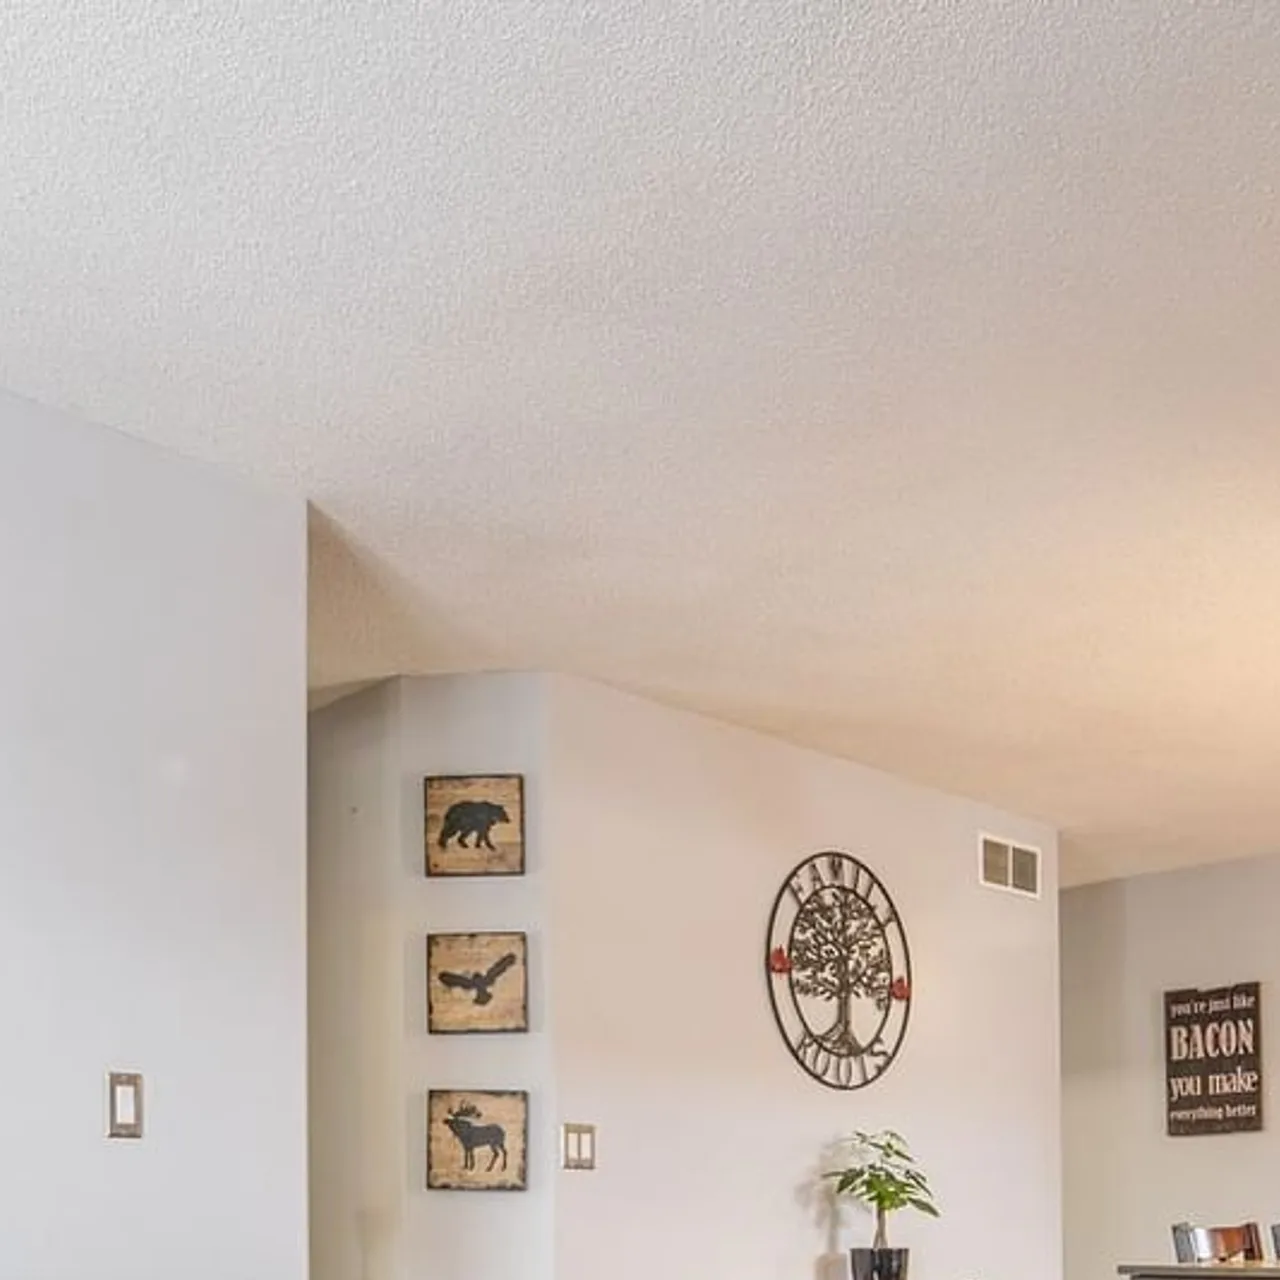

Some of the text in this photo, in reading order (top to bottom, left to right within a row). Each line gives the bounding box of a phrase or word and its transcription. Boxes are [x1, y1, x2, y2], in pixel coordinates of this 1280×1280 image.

[787, 856, 898, 928] FAMILY
[1170, 993, 1256, 1017] you're just like
[1170, 1018, 1254, 1060] BACON
[795, 1031, 891, 1086] ROOTS
[1170, 1065, 1258, 1100] you make
[1170, 1103, 1256, 1121] everything better
